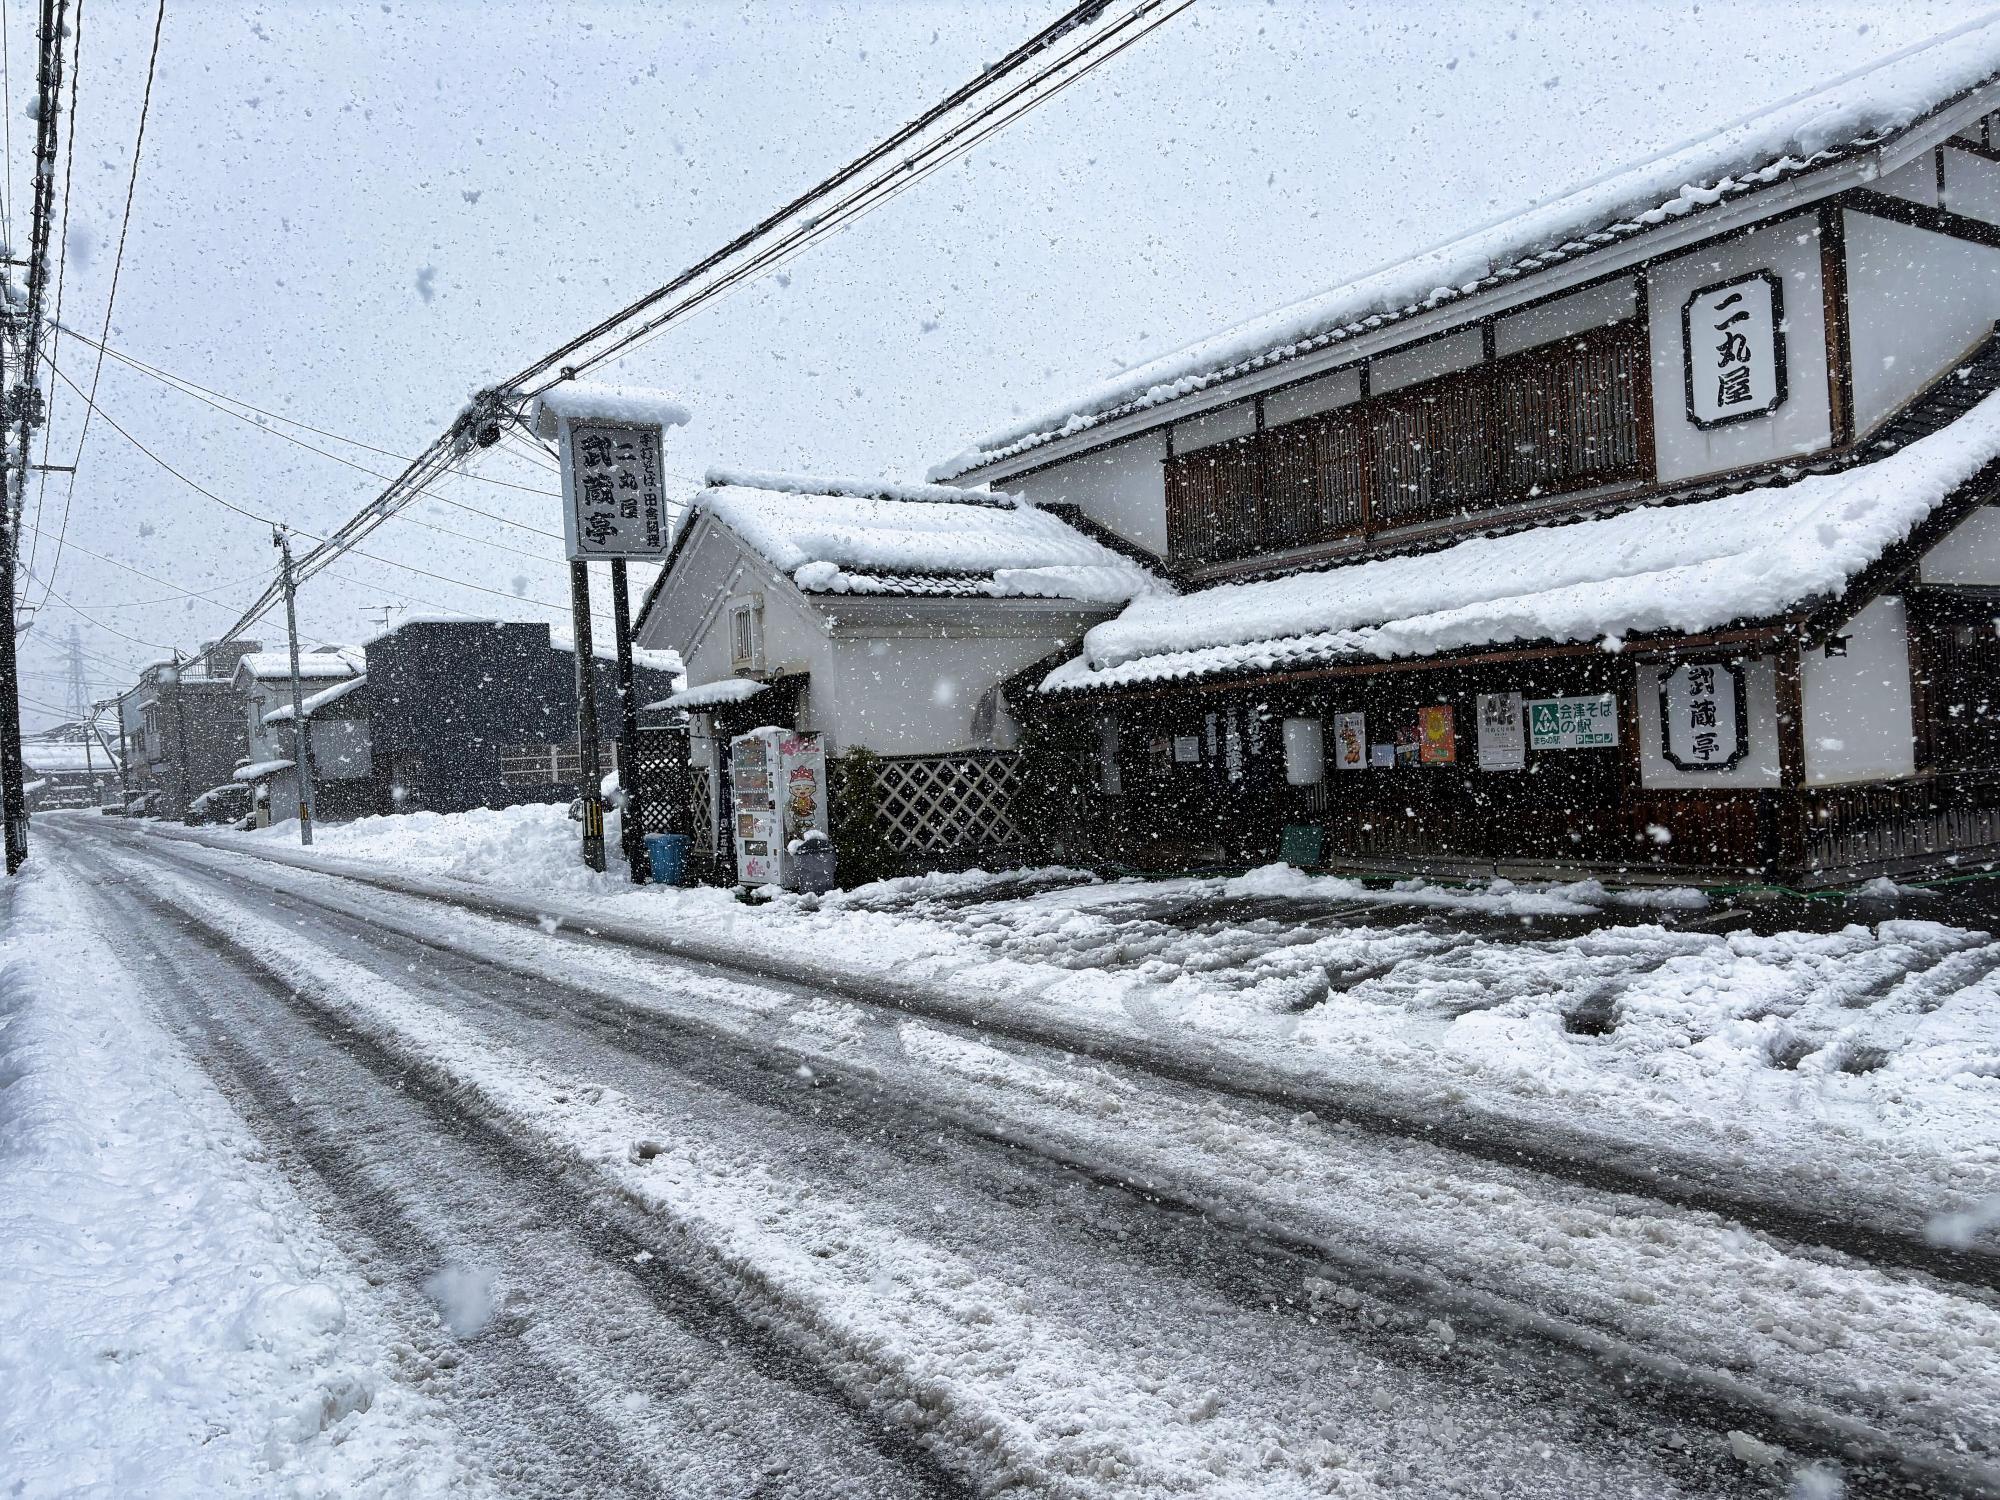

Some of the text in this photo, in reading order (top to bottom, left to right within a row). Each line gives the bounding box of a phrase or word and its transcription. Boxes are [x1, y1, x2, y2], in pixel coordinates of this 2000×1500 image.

[1713, 293, 1752, 407] 二丸屋
[581, 434, 618, 545] 武蔵亭
[616, 443, 638, 519] 二丸屋
[1534, 736, 1560, 745] まちの駅
[1560, 701, 1612, 719] 会津そば
[1561, 719, 1592, 733] の駅
[1688, 667, 1720, 761] 武蔵亭
